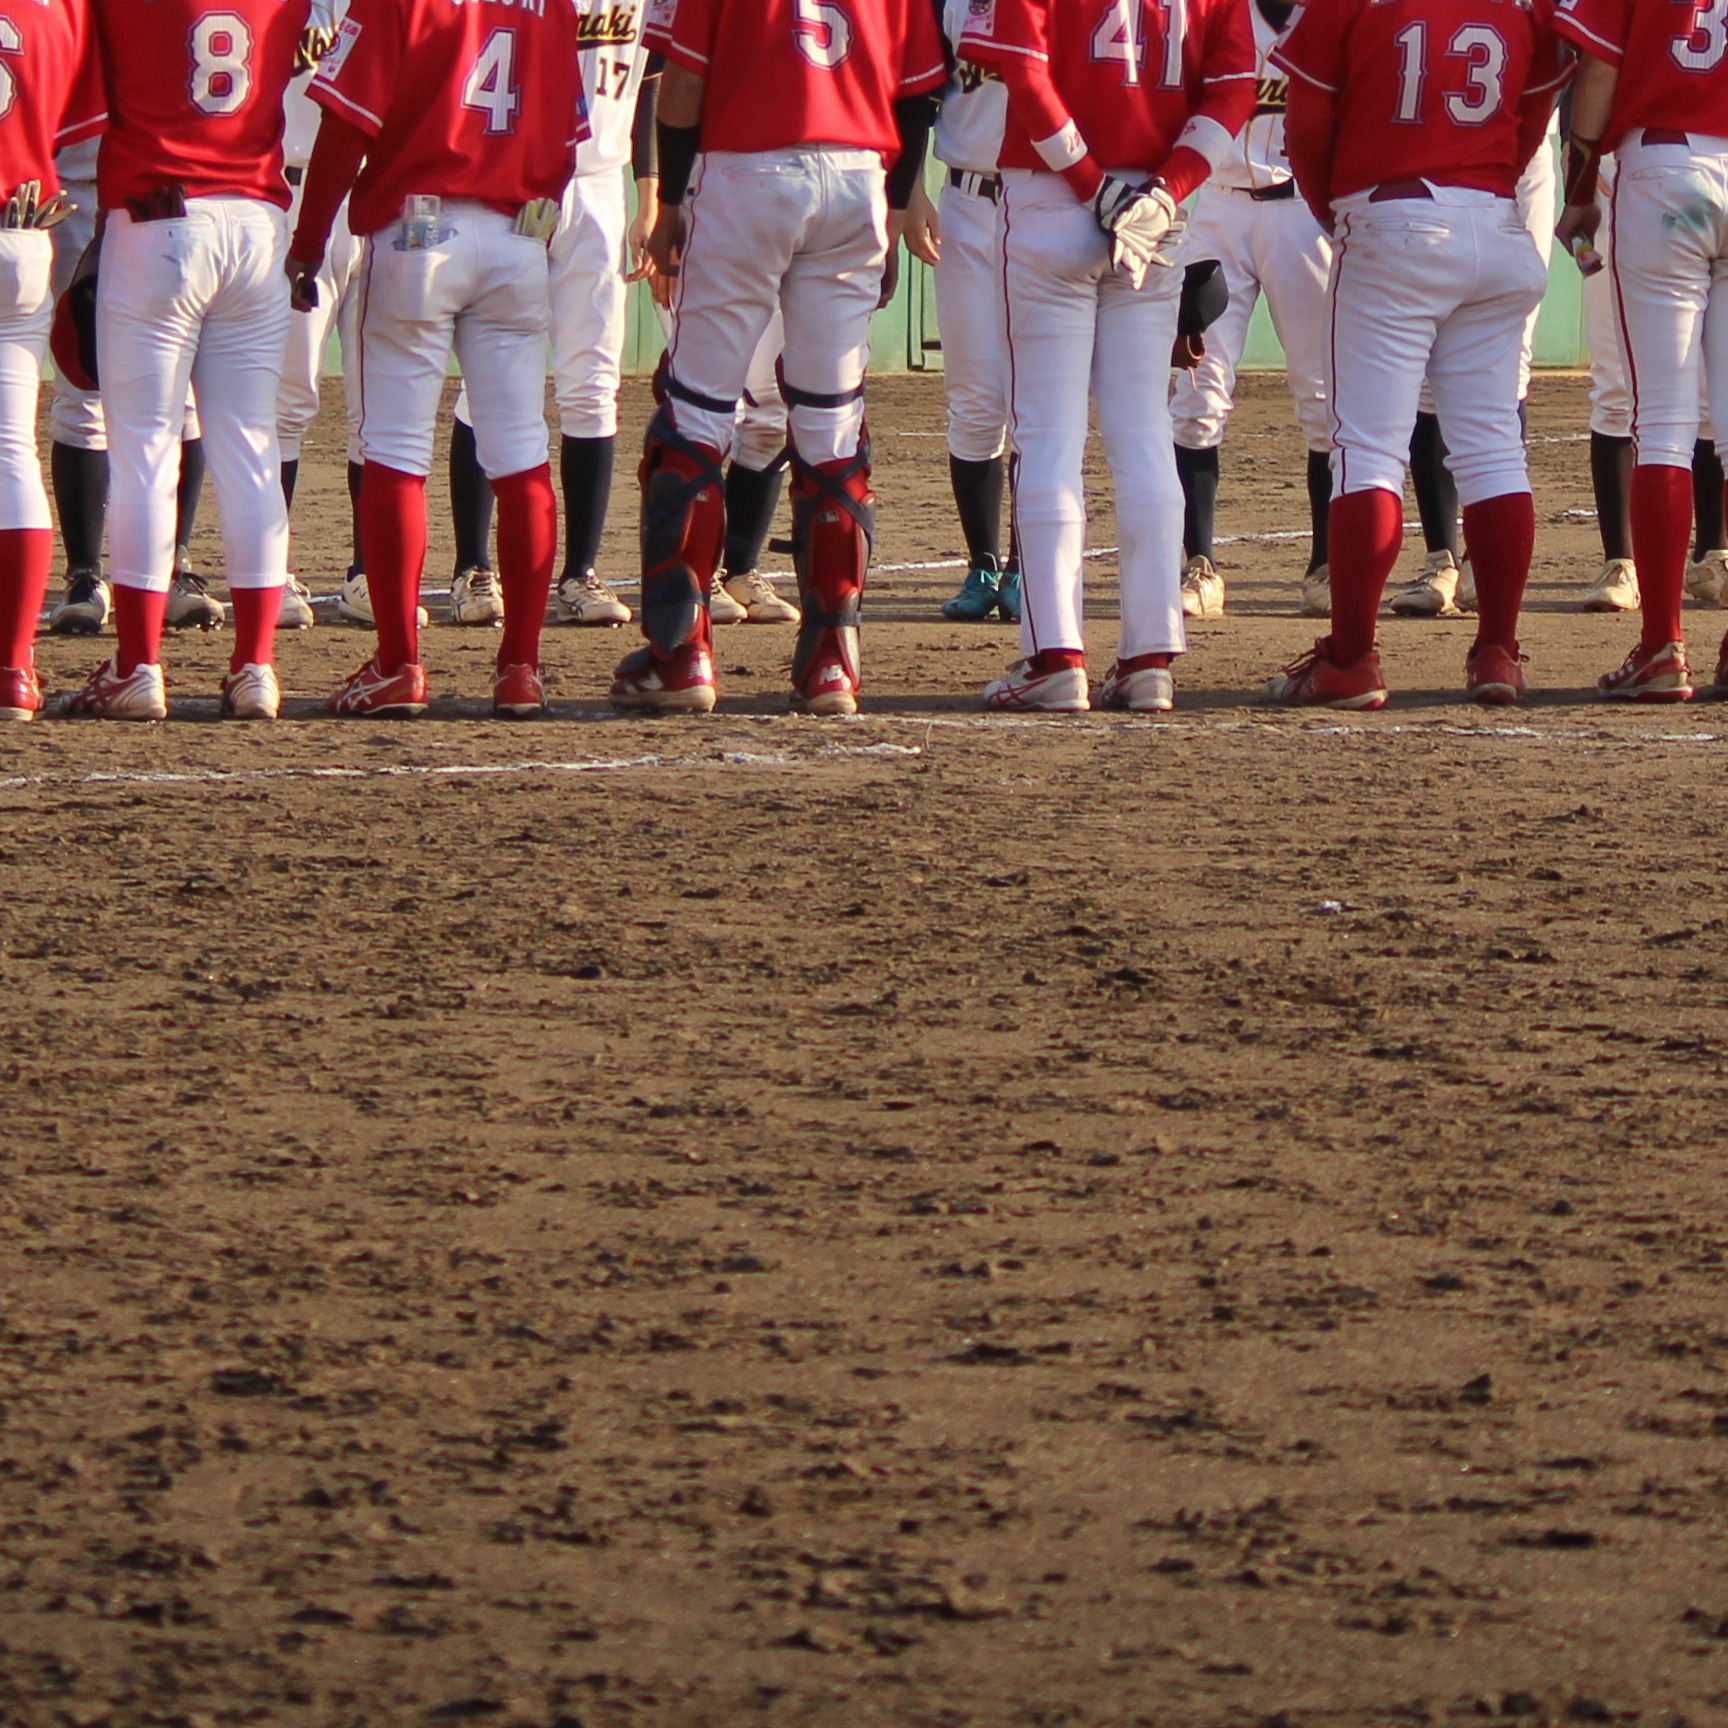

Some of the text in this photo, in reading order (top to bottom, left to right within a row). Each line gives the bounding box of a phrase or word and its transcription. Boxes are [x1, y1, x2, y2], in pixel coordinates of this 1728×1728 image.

[187, 10, 255, 117] 8
[460, 27, 522, 137] 4
[595, 56, 632, 101] 17
[1390, 19, 1509, 127] 13
